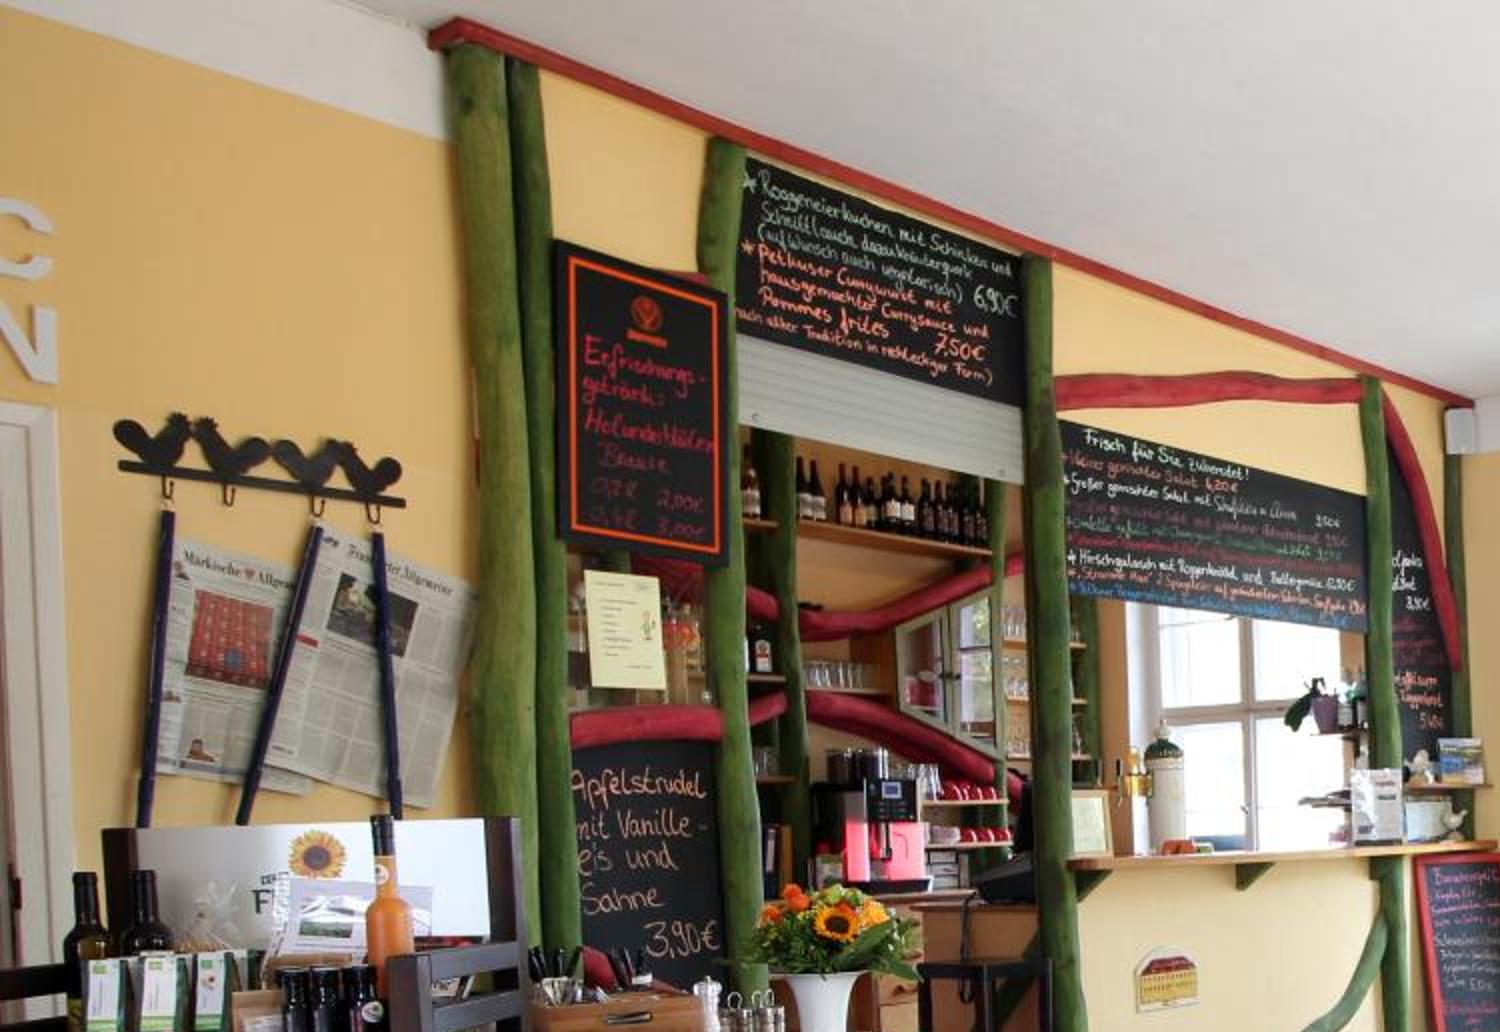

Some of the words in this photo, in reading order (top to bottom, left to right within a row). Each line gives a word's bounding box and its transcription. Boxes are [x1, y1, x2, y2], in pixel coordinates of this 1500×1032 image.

[899, 228, 928, 247] mit
[991, 259, 1013, 278] und
[759, 285, 833, 323] Pommes
[962, 320, 991, 339] und
[1082, 427, 1127, 456] Frisch
[1132, 440, 1155, 463] für
[1157, 445, 1184, 468] Sie
[570, 768, 707, 811] Apfelstrudel
[626, 842, 679, 871] und
[581, 880, 666, 916] Sahne
[643, 918, 722, 960] 3,90€
